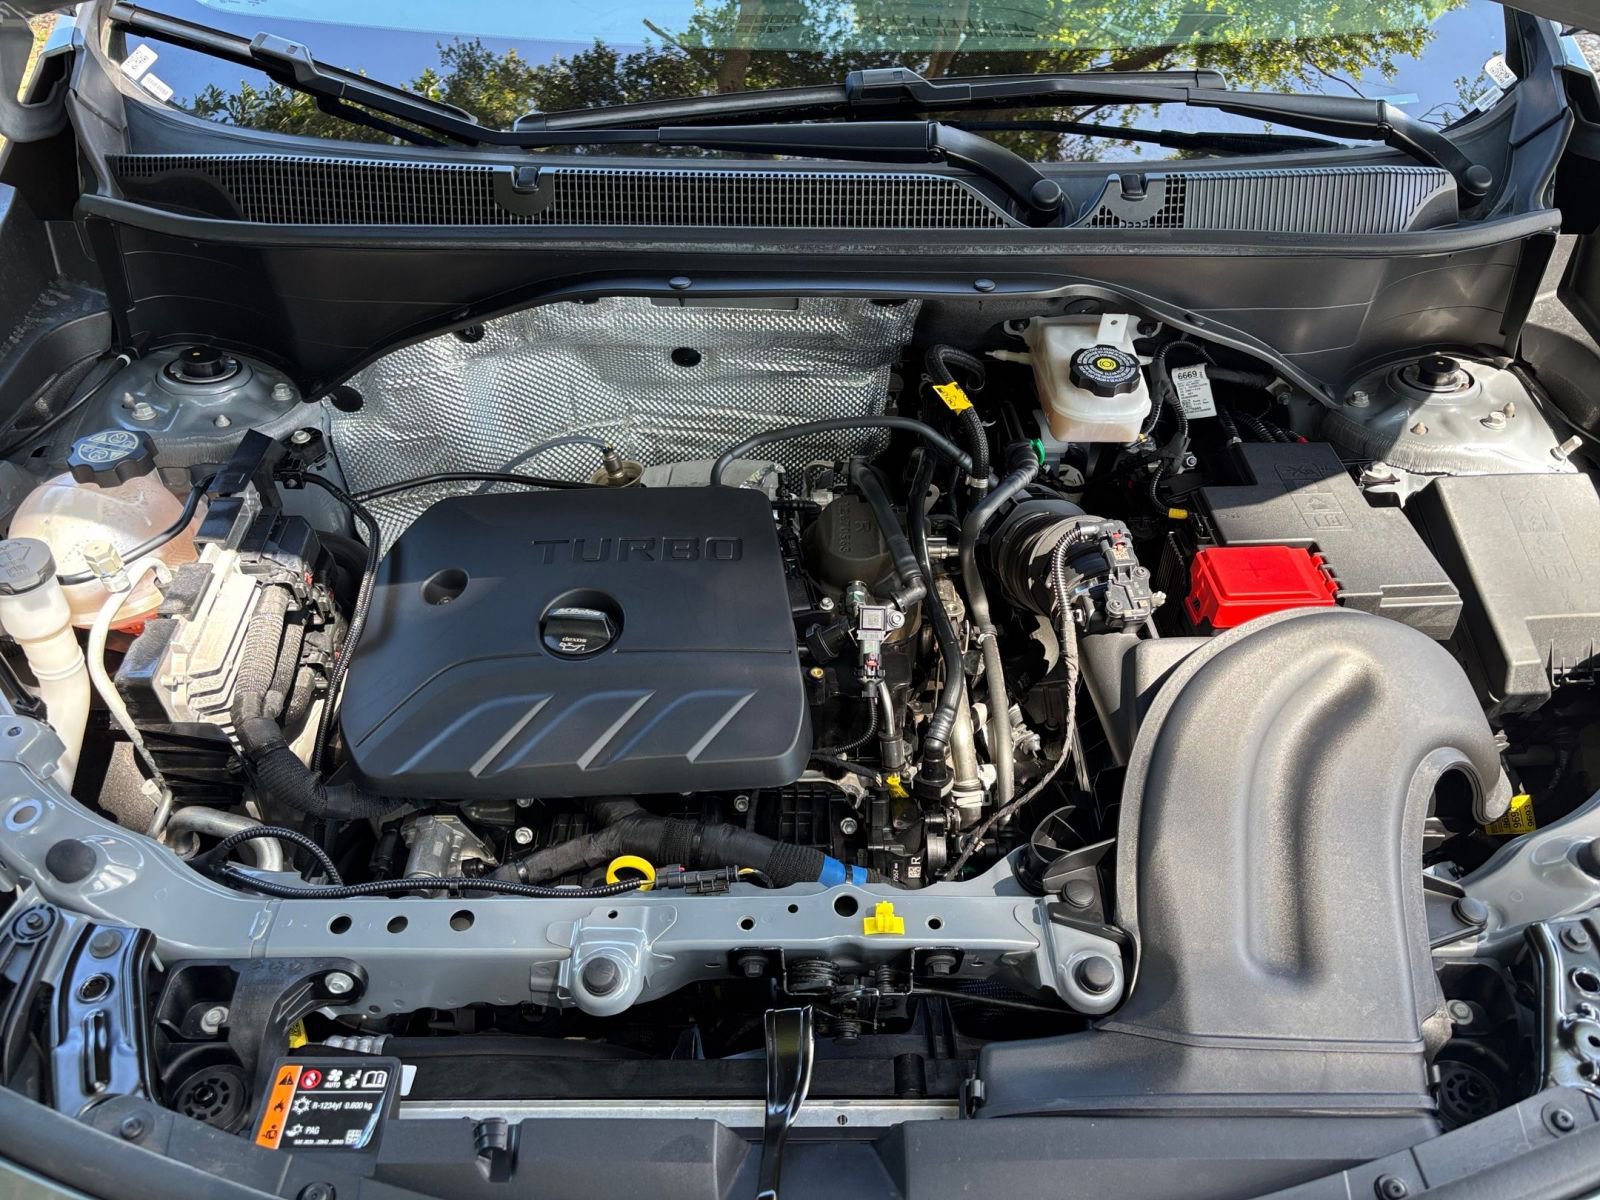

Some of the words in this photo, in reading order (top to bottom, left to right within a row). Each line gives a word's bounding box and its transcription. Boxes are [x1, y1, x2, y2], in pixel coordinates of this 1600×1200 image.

[1178, 370, 1198, 380] 6669
[531, 536, 743, 565] TURBO
[911, 857, 921, 865] R
[311, 1101, 342, 1110] R-1234yf
[364, 1101, 373, 1111] kg
[305, 1126, 320, 1135] PAG
